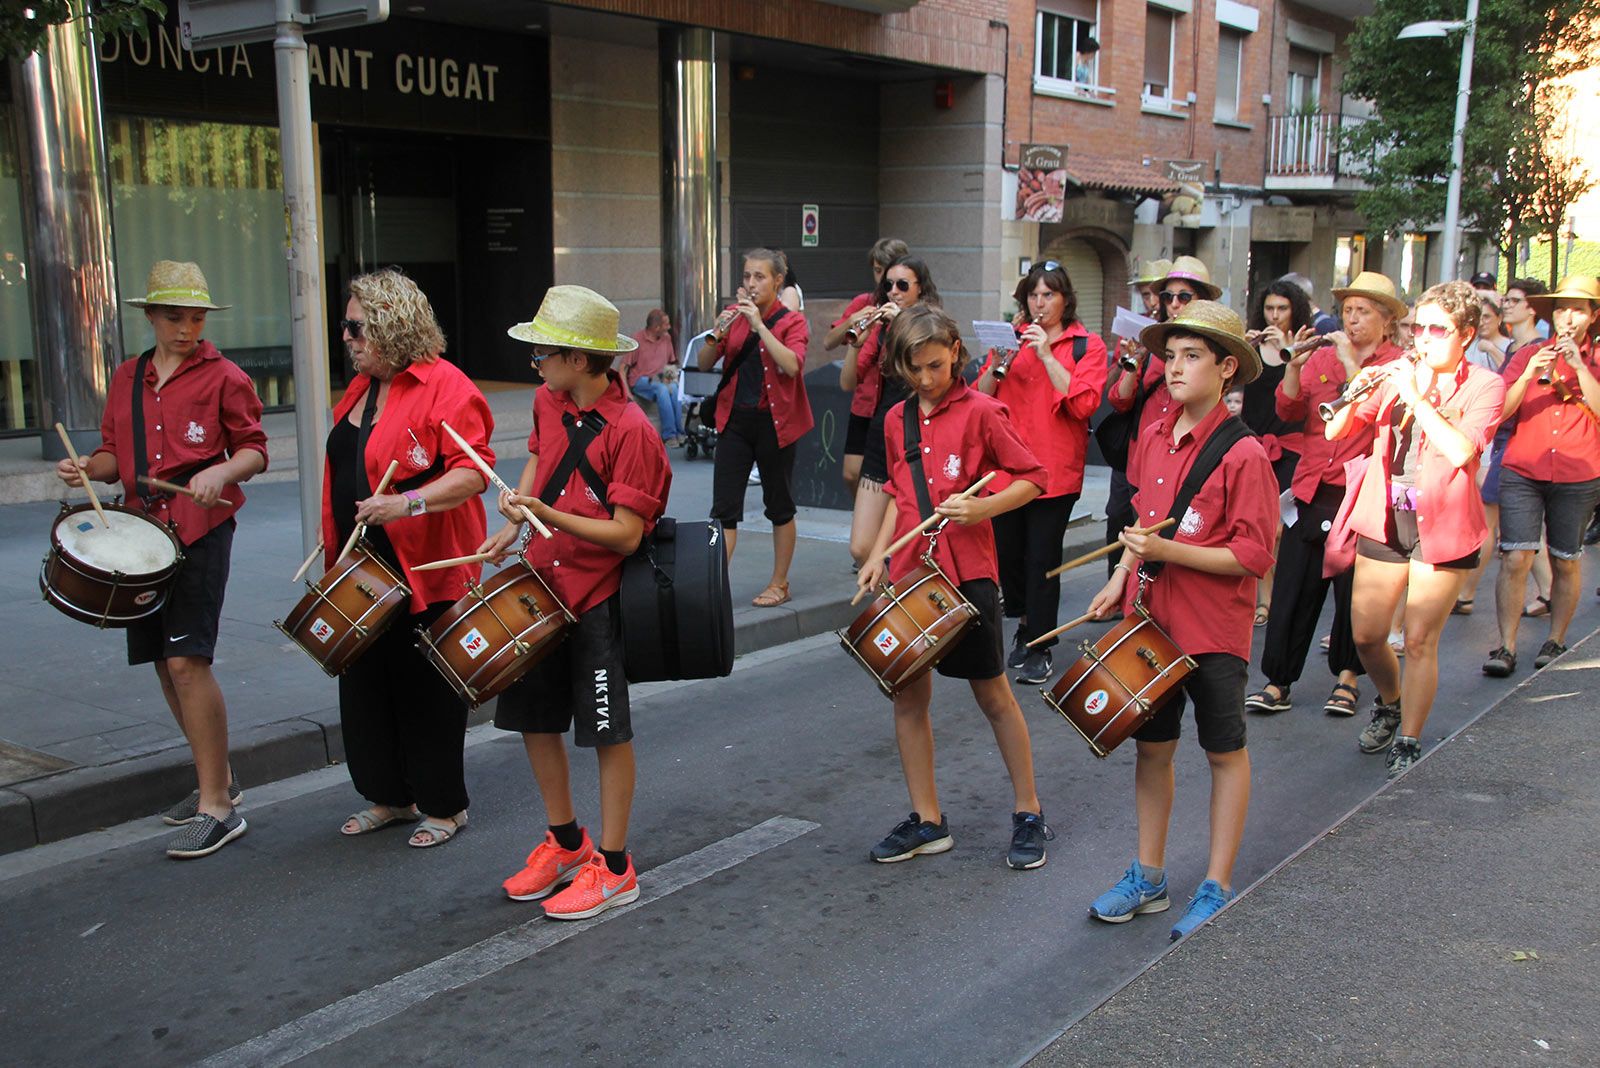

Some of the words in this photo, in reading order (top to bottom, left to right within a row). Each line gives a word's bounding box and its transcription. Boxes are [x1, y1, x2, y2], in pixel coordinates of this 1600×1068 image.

[303, 42, 374, 91] ANT
[395, 53, 499, 102] CUGAT
[1035, 156, 1060, 168] Grau
[467, 636, 481, 653] NP
[880, 636, 892, 651] NP
[594, 669, 610, 732] NKTVK
[1086, 698, 1098, 712] NP
